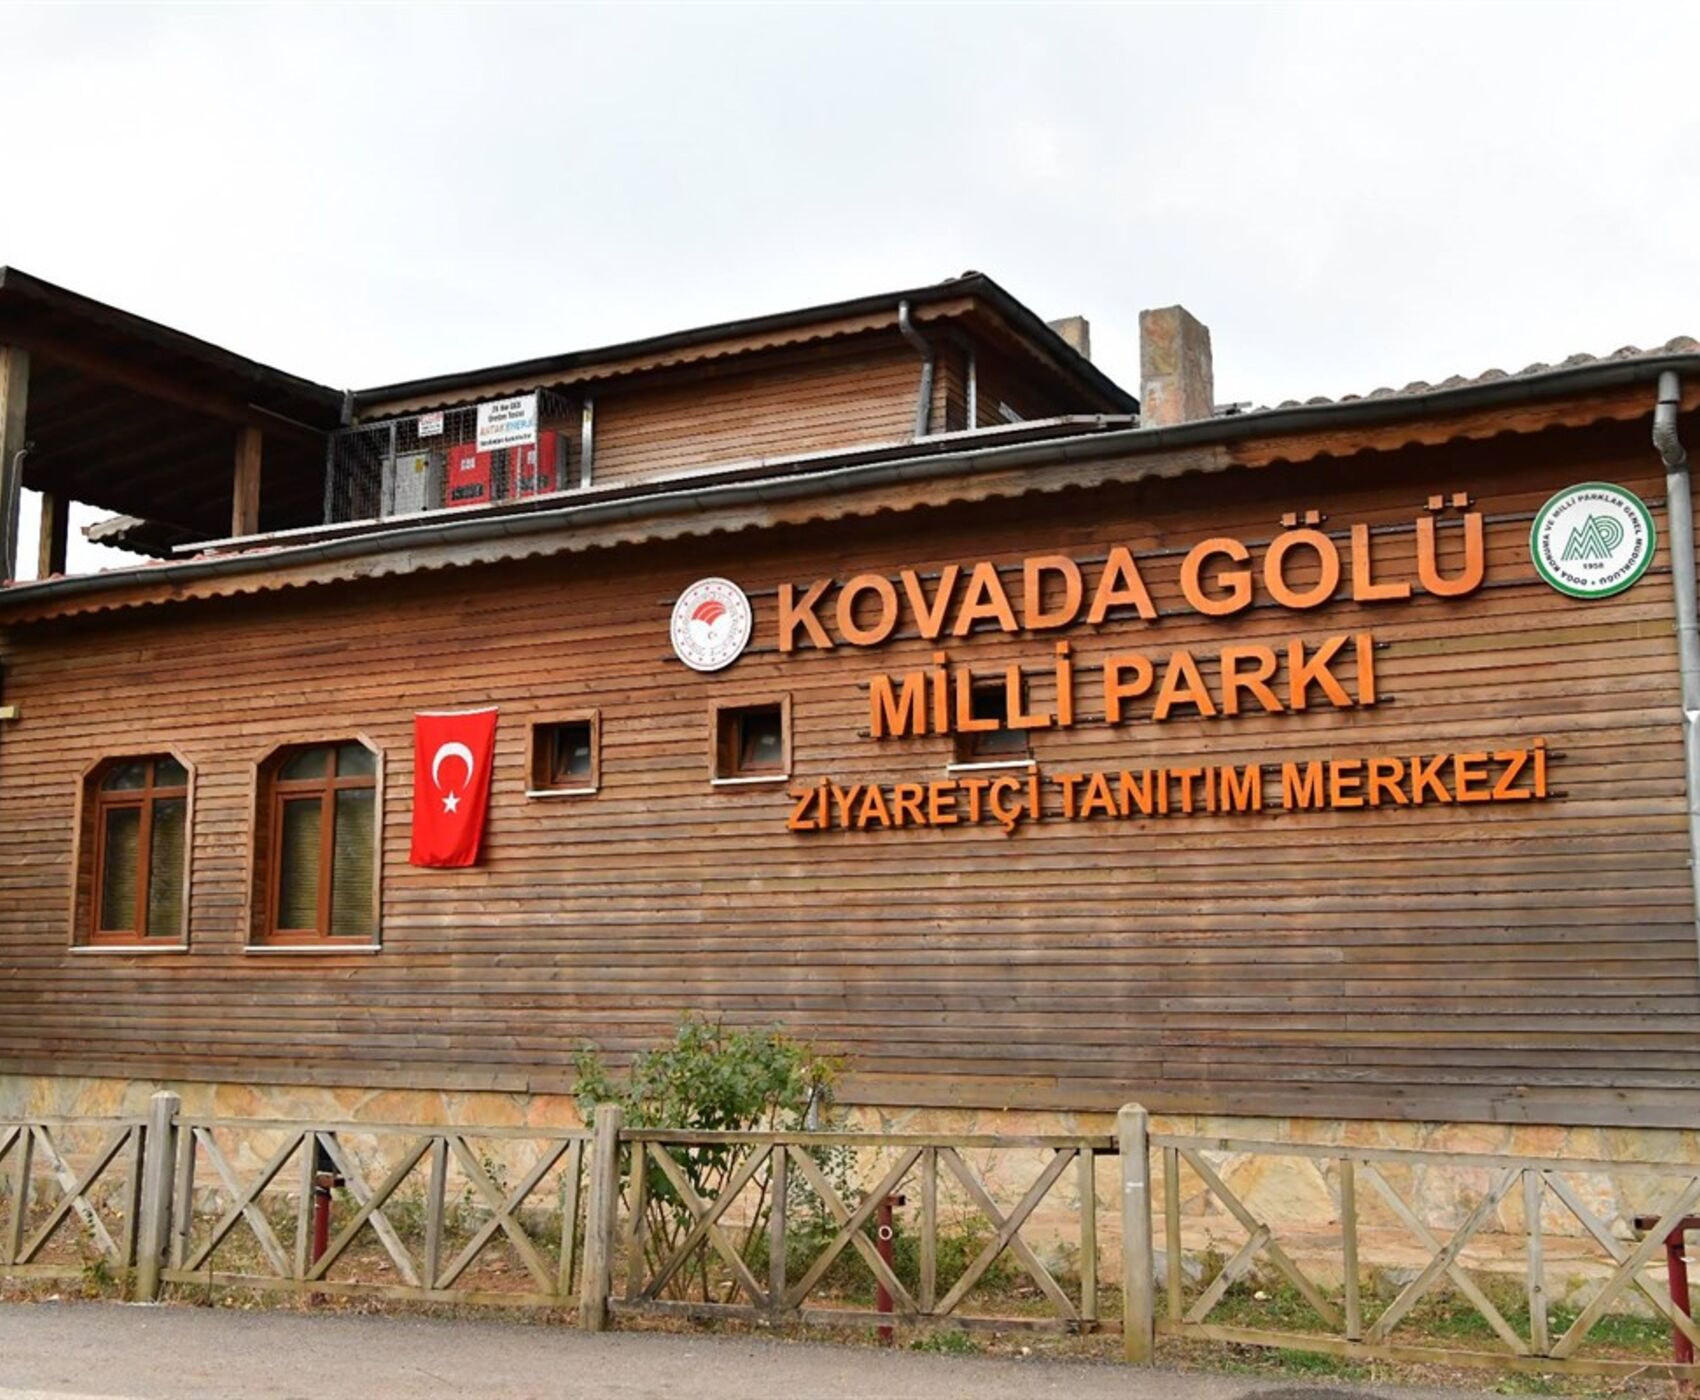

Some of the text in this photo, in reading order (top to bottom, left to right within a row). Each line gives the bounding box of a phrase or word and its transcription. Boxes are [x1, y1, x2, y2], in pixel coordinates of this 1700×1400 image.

[1544, 520, 1555, 532] VE
[1578, 494, 1624, 508] PARKLAR
[1623, 506, 1642, 535] GENEL
[777, 546, 1157, 652] KOVADA
[1180, 492, 1485, 616] GÖLÜ
[869, 633, 1375, 738] MİLLİ PARKI
[787, 737, 1547, 833] ZİYARETÇİ TANITIM MERKEZİ
